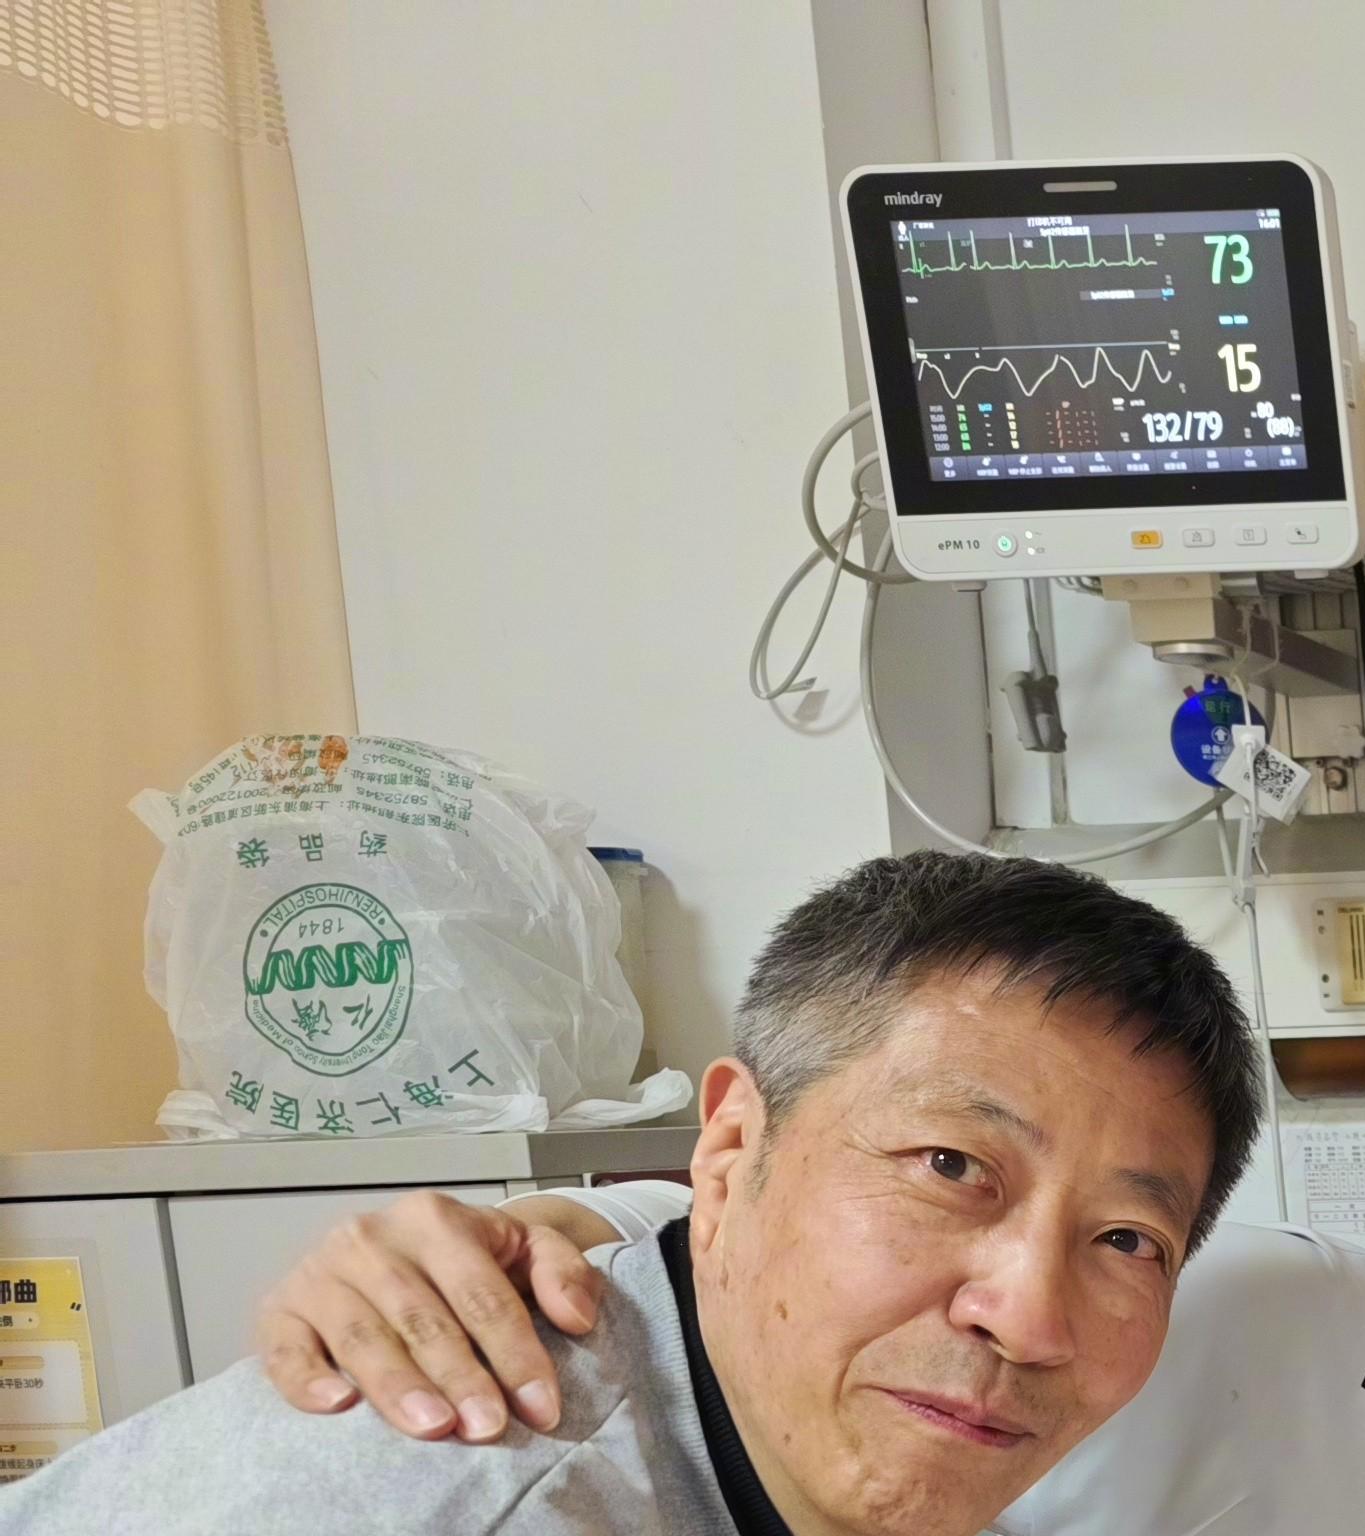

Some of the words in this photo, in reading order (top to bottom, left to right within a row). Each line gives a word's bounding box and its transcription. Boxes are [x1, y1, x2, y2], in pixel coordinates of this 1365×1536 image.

[884, 191, 943, 207] mindray
[1204, 234, 1253, 284] 73
[1218, 343, 1261, 393] 15
[1142, 410, 1223, 442] 132/79
[938, 540, 963, 550] ePM
[966, 540, 980, 549] 10
[236, 829, 387, 869] 药品袋
[299, 917, 345, 938] 1844
[226, 1048, 494, 1134] 上海仁济医院
